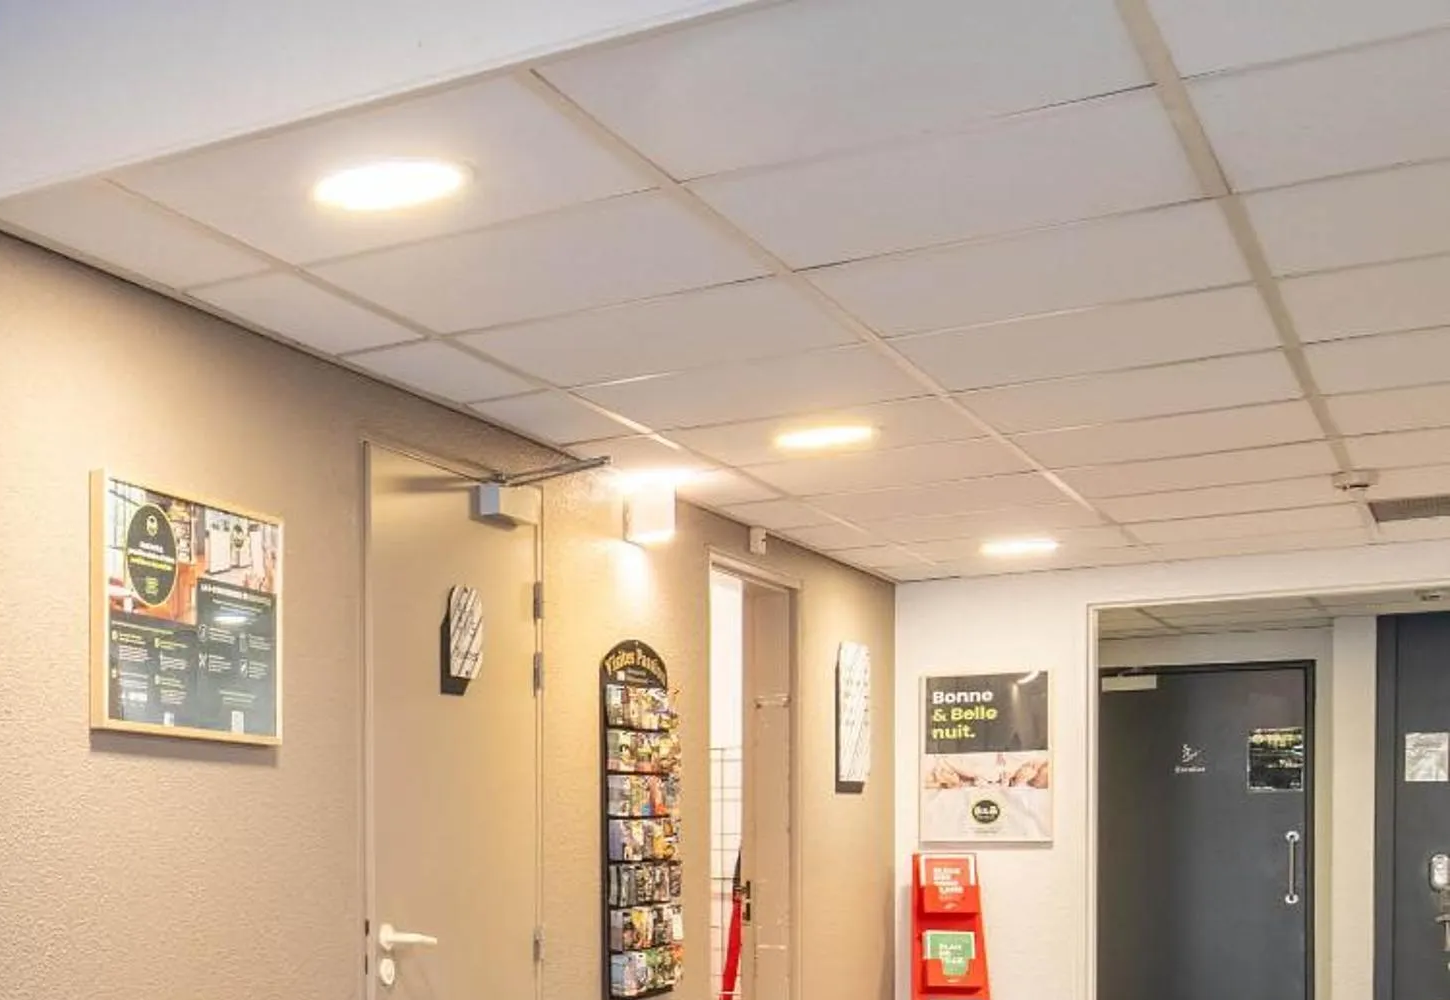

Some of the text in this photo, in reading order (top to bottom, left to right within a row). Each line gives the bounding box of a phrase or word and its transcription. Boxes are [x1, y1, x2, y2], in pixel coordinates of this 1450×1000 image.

[932, 690, 994, 705] Bonne
[933, 705, 998, 722] & Belle
[932, 724, 977, 740] nuit.
